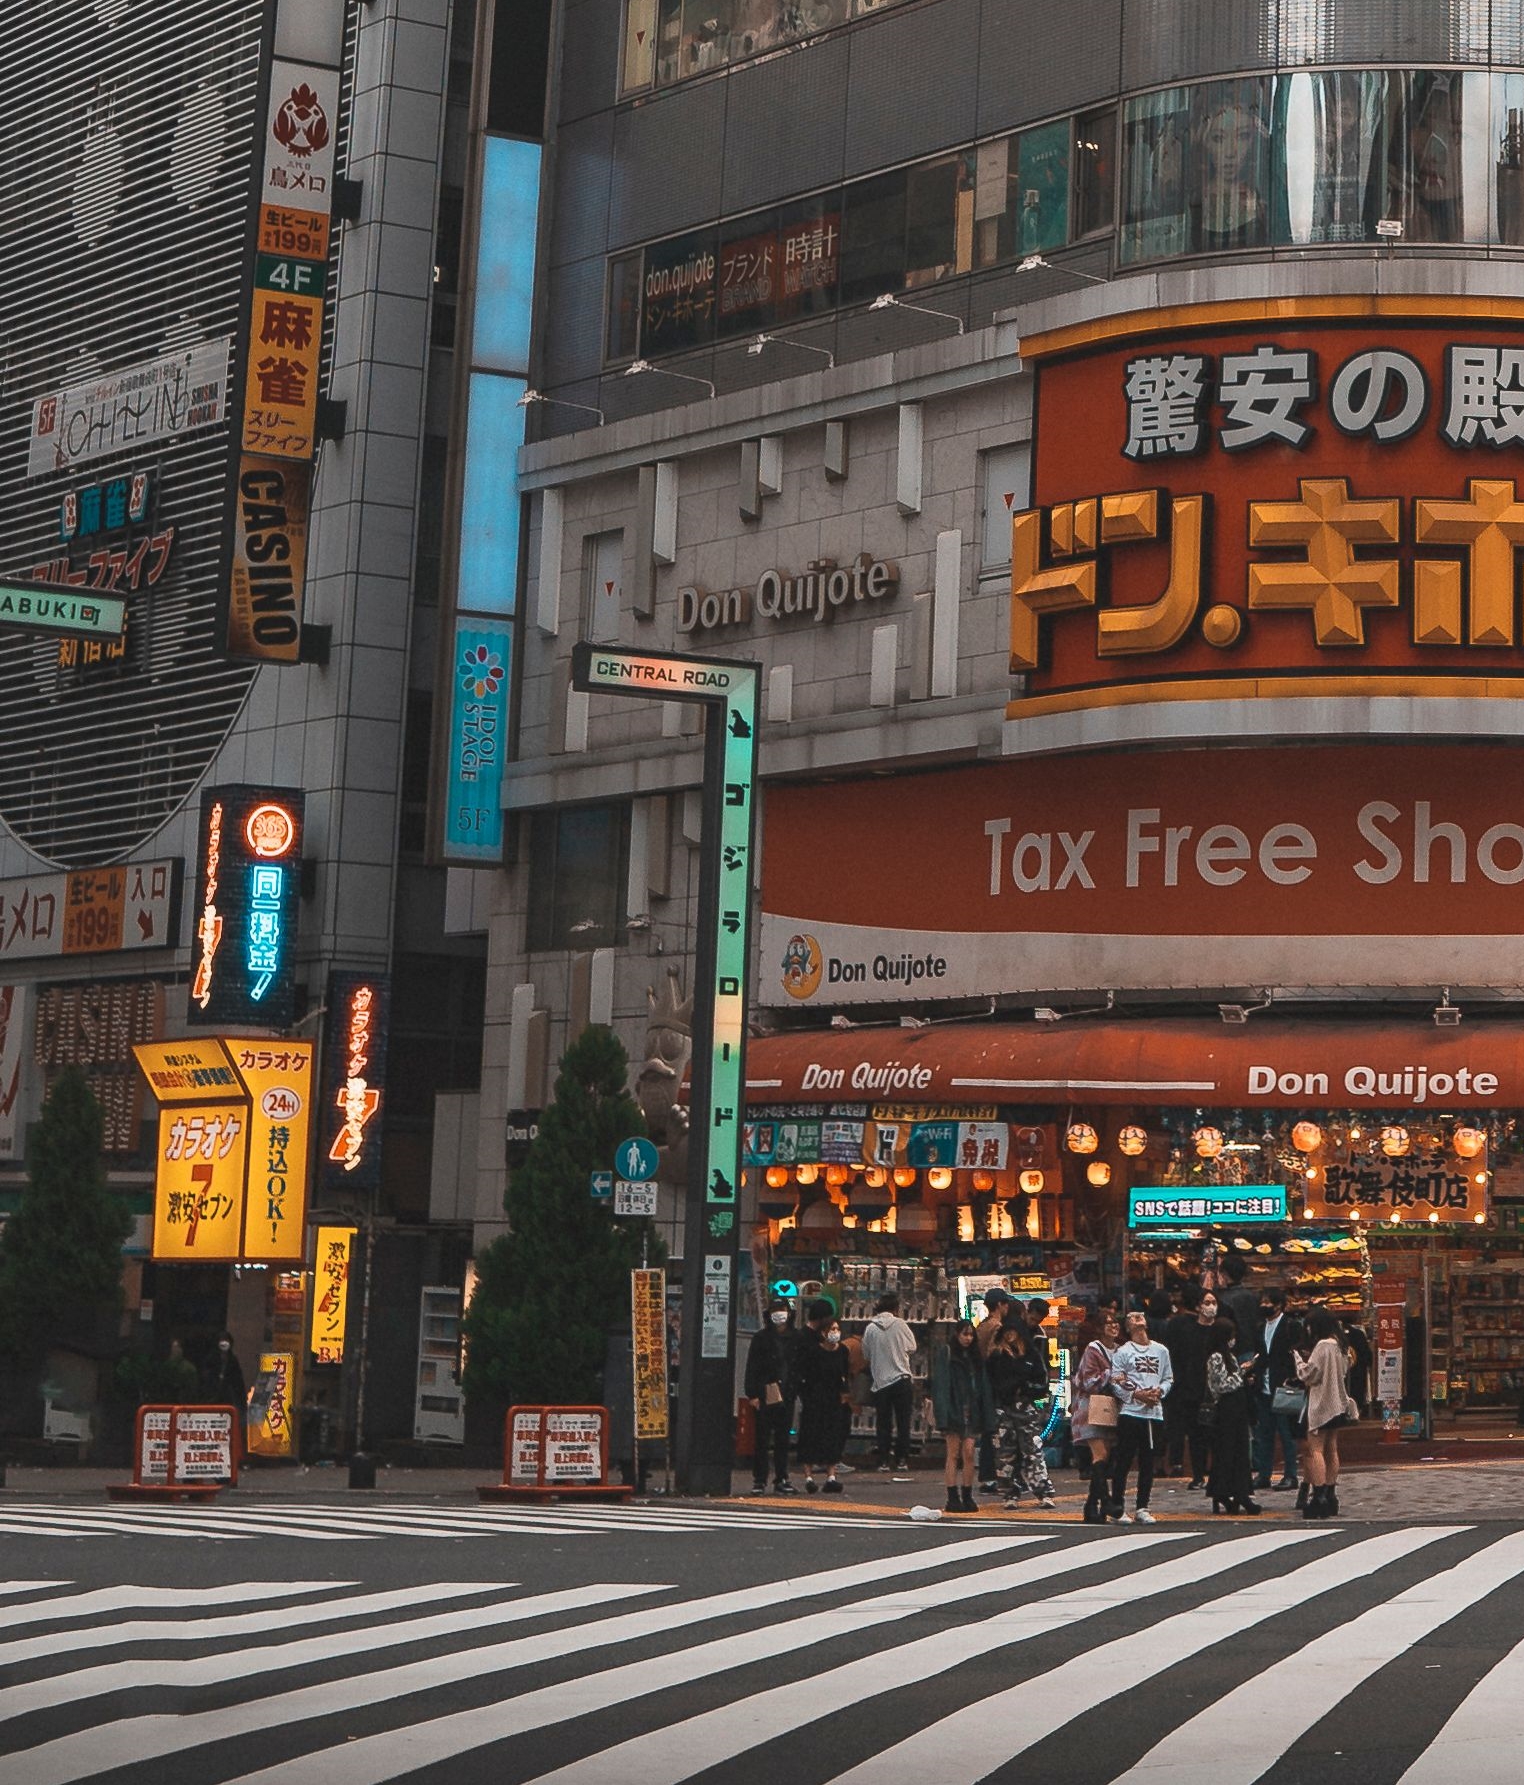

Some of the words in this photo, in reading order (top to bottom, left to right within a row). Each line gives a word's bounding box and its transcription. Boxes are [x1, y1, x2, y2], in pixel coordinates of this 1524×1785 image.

[269, 166, 326, 194] 鳥メロ
[266, 210, 322, 232] 生ビール
[785, 225, 838, 264] 時計
[269, 262, 312, 291] 4F
[646, 252, 715, 297] don.quijote
[723, 246, 773, 286] ブランド
[784, 258, 836, 294] WATCH
[722, 276, 772, 311] BRAND
[258, 300, 313, 408] 麻雀
[248, 409, 296, 427] スリー
[247, 429, 309, 449] ファイブ
[240, 470, 298, 645] CASINO
[677, 586, 744, 633] Don
[756, 553, 894, 622] Quijote
[597, 661, 677, 683] CENTRAL
[684, 671, 730, 688] ROAD
[461, 703, 481, 782] STAGE
[477, 705, 497, 767] IDOL
[459, 807, 490, 831] 5F
[984, 817, 1096, 895] Tax
[1126, 808, 1317, 887] Free
[70, 873, 121, 905] 生ビール
[131, 869, 166, 901] 入口
[714, 783, 751, 1128] ゴジラロード
[828, 958, 866, 983] Don
[873, 954, 947, 985] Quijote
[240, 1050, 308, 1071] カラオケ
[801, 1064, 845, 1090] Don
[851, 1061, 932, 1096] Quijote
[1248, 1066, 1329, 1094] Don
[1344, 1066, 1498, 1103] Quijote
[165, 1115, 241, 1160] カラオケ
[1325, 1167, 1470, 1209] 歌舞伎町店
[167, 1192, 233, 1223] 激安セブン
